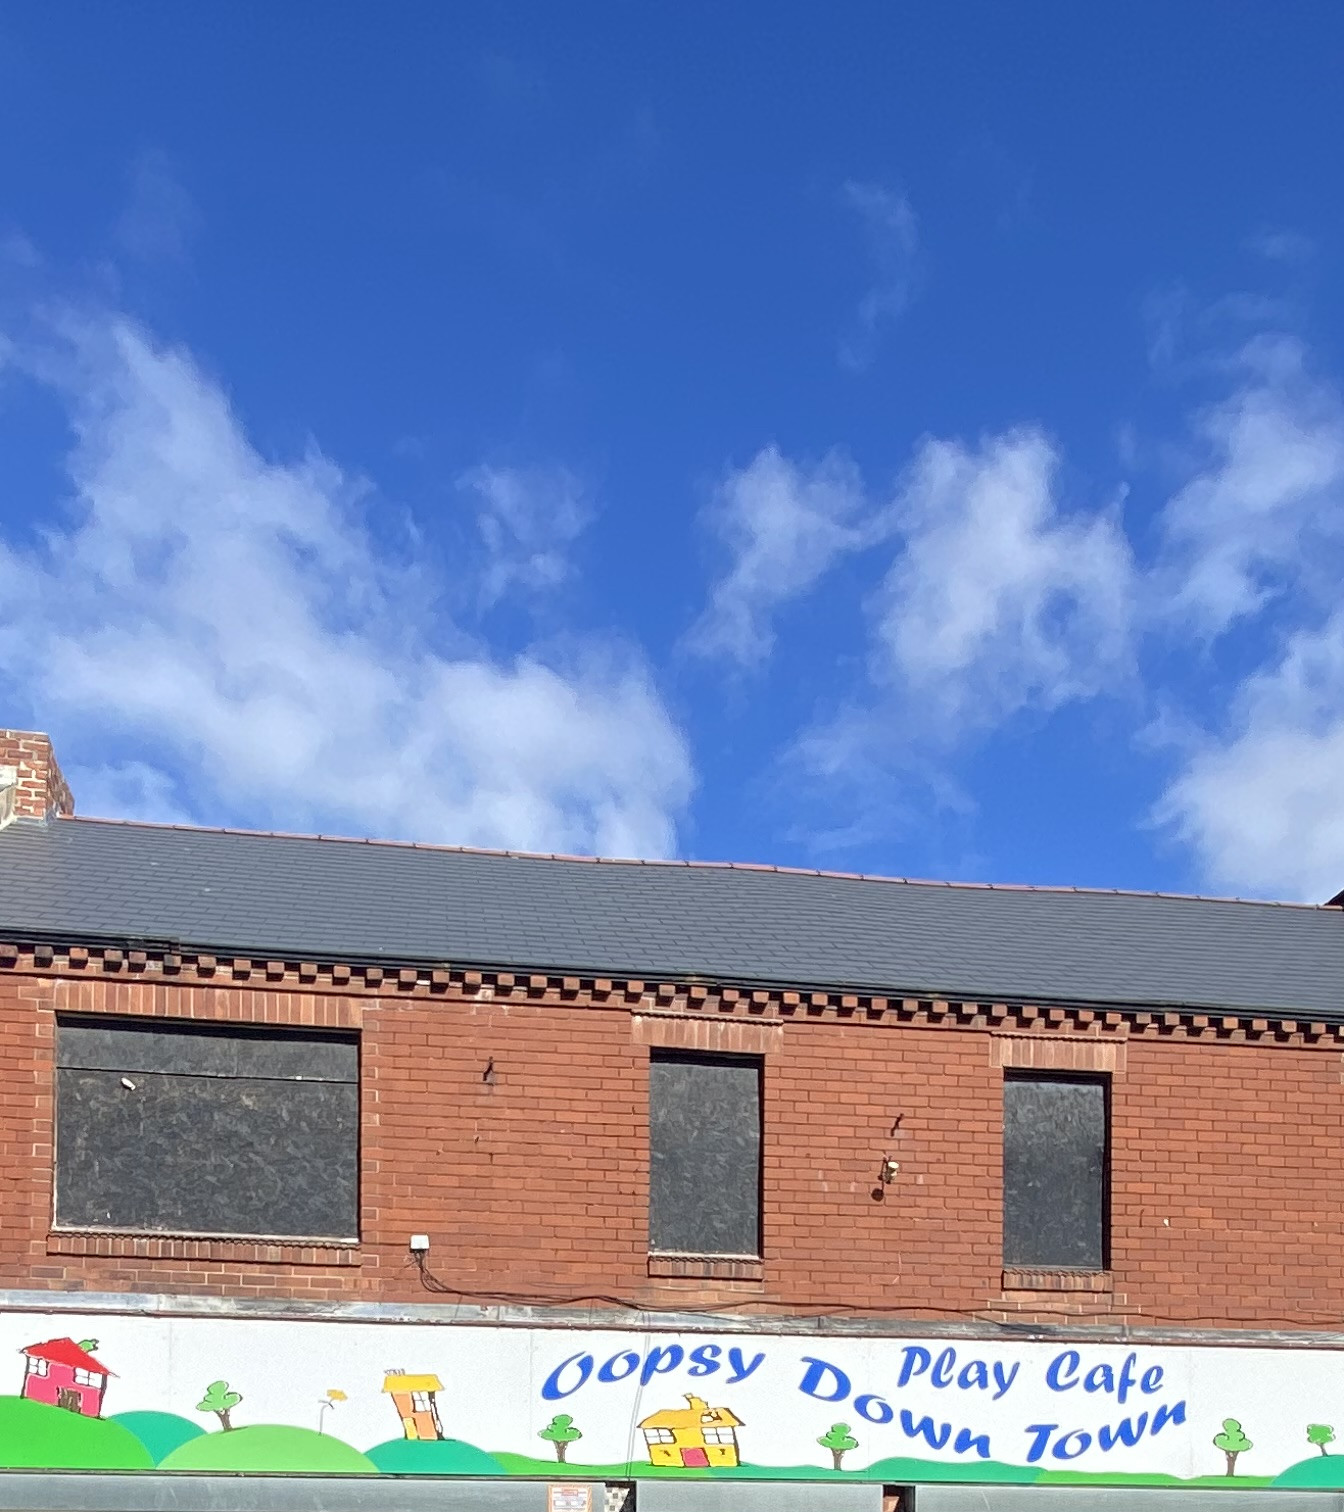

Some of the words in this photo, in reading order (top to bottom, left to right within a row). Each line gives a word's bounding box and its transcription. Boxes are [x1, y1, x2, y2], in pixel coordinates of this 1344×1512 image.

[542, 1344, 765, 1400] Oopsy
[799, 1356, 991, 1458] Down
[1026, 1400, 1187, 1463] Town
[897, 1346, 1019, 1399] Play
[1046, 1351, 1164, 1403] Cafe
